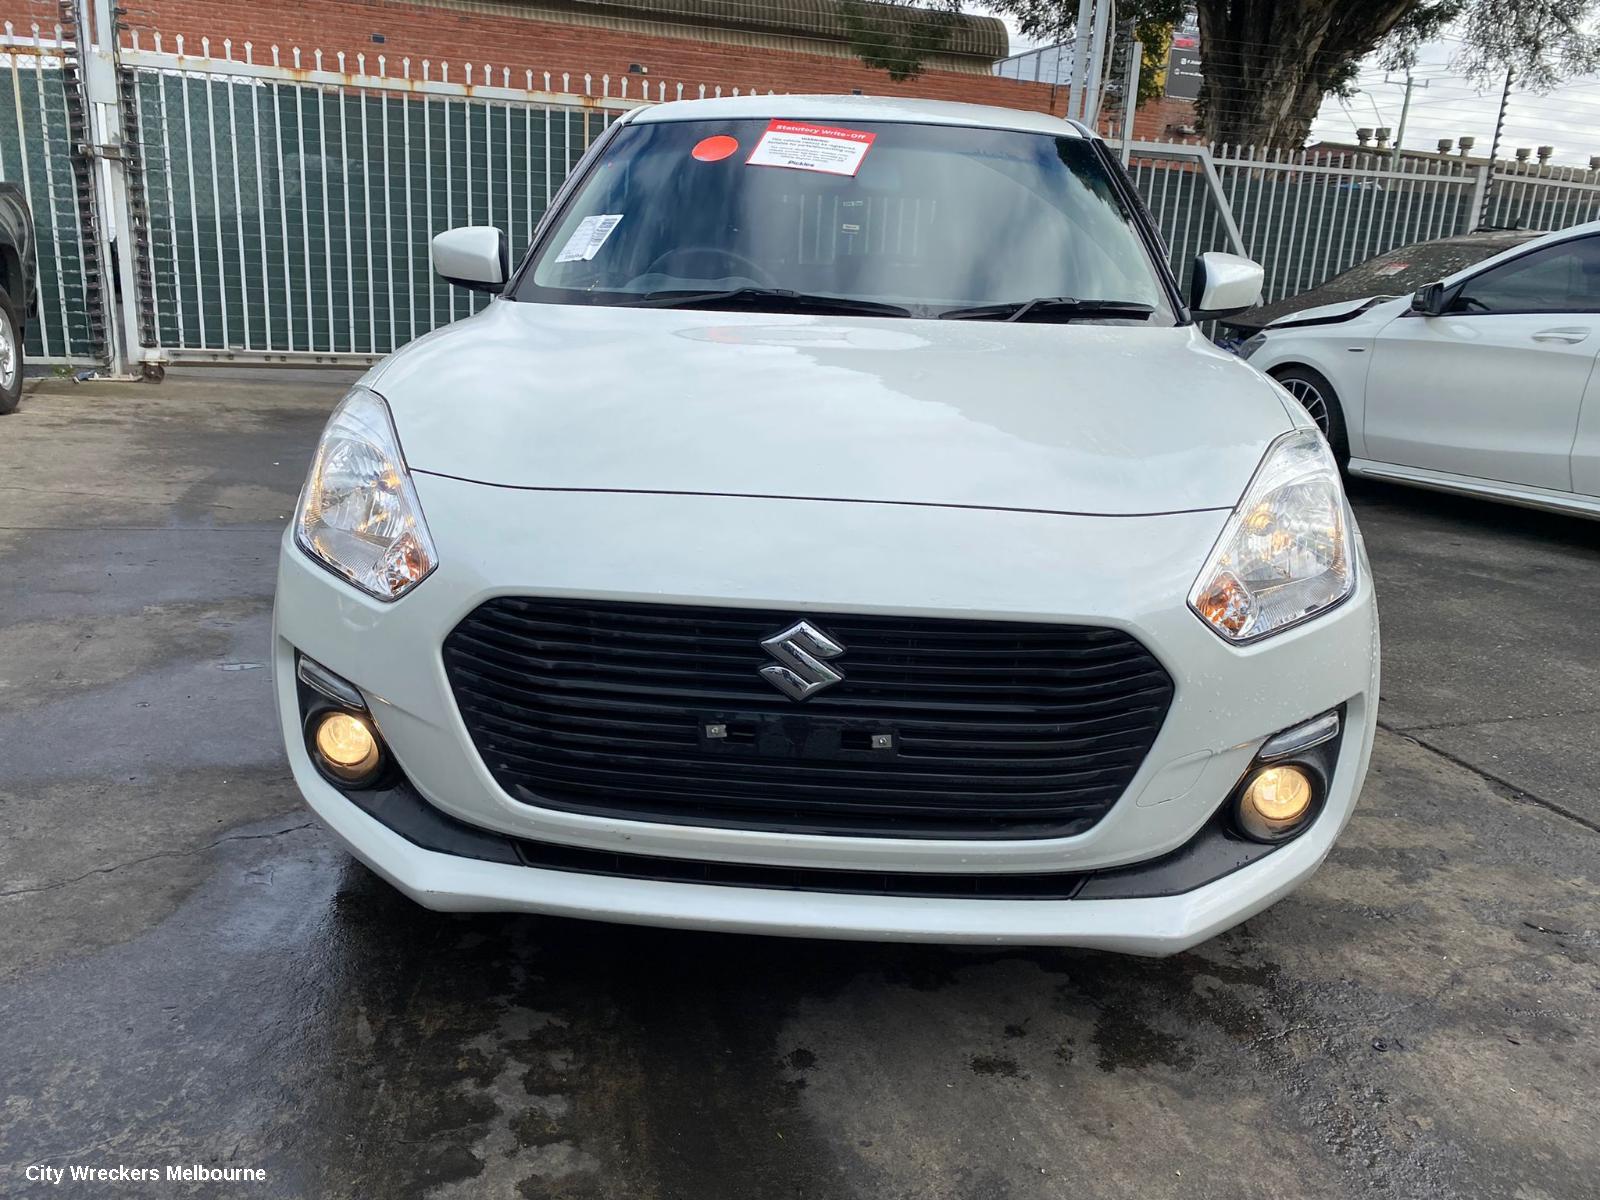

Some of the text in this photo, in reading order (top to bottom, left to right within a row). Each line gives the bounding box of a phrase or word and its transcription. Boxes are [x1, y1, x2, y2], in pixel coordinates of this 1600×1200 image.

[776, 124, 867, 140] Statutory Write-Off
[787, 160, 815, 168] Pickles
